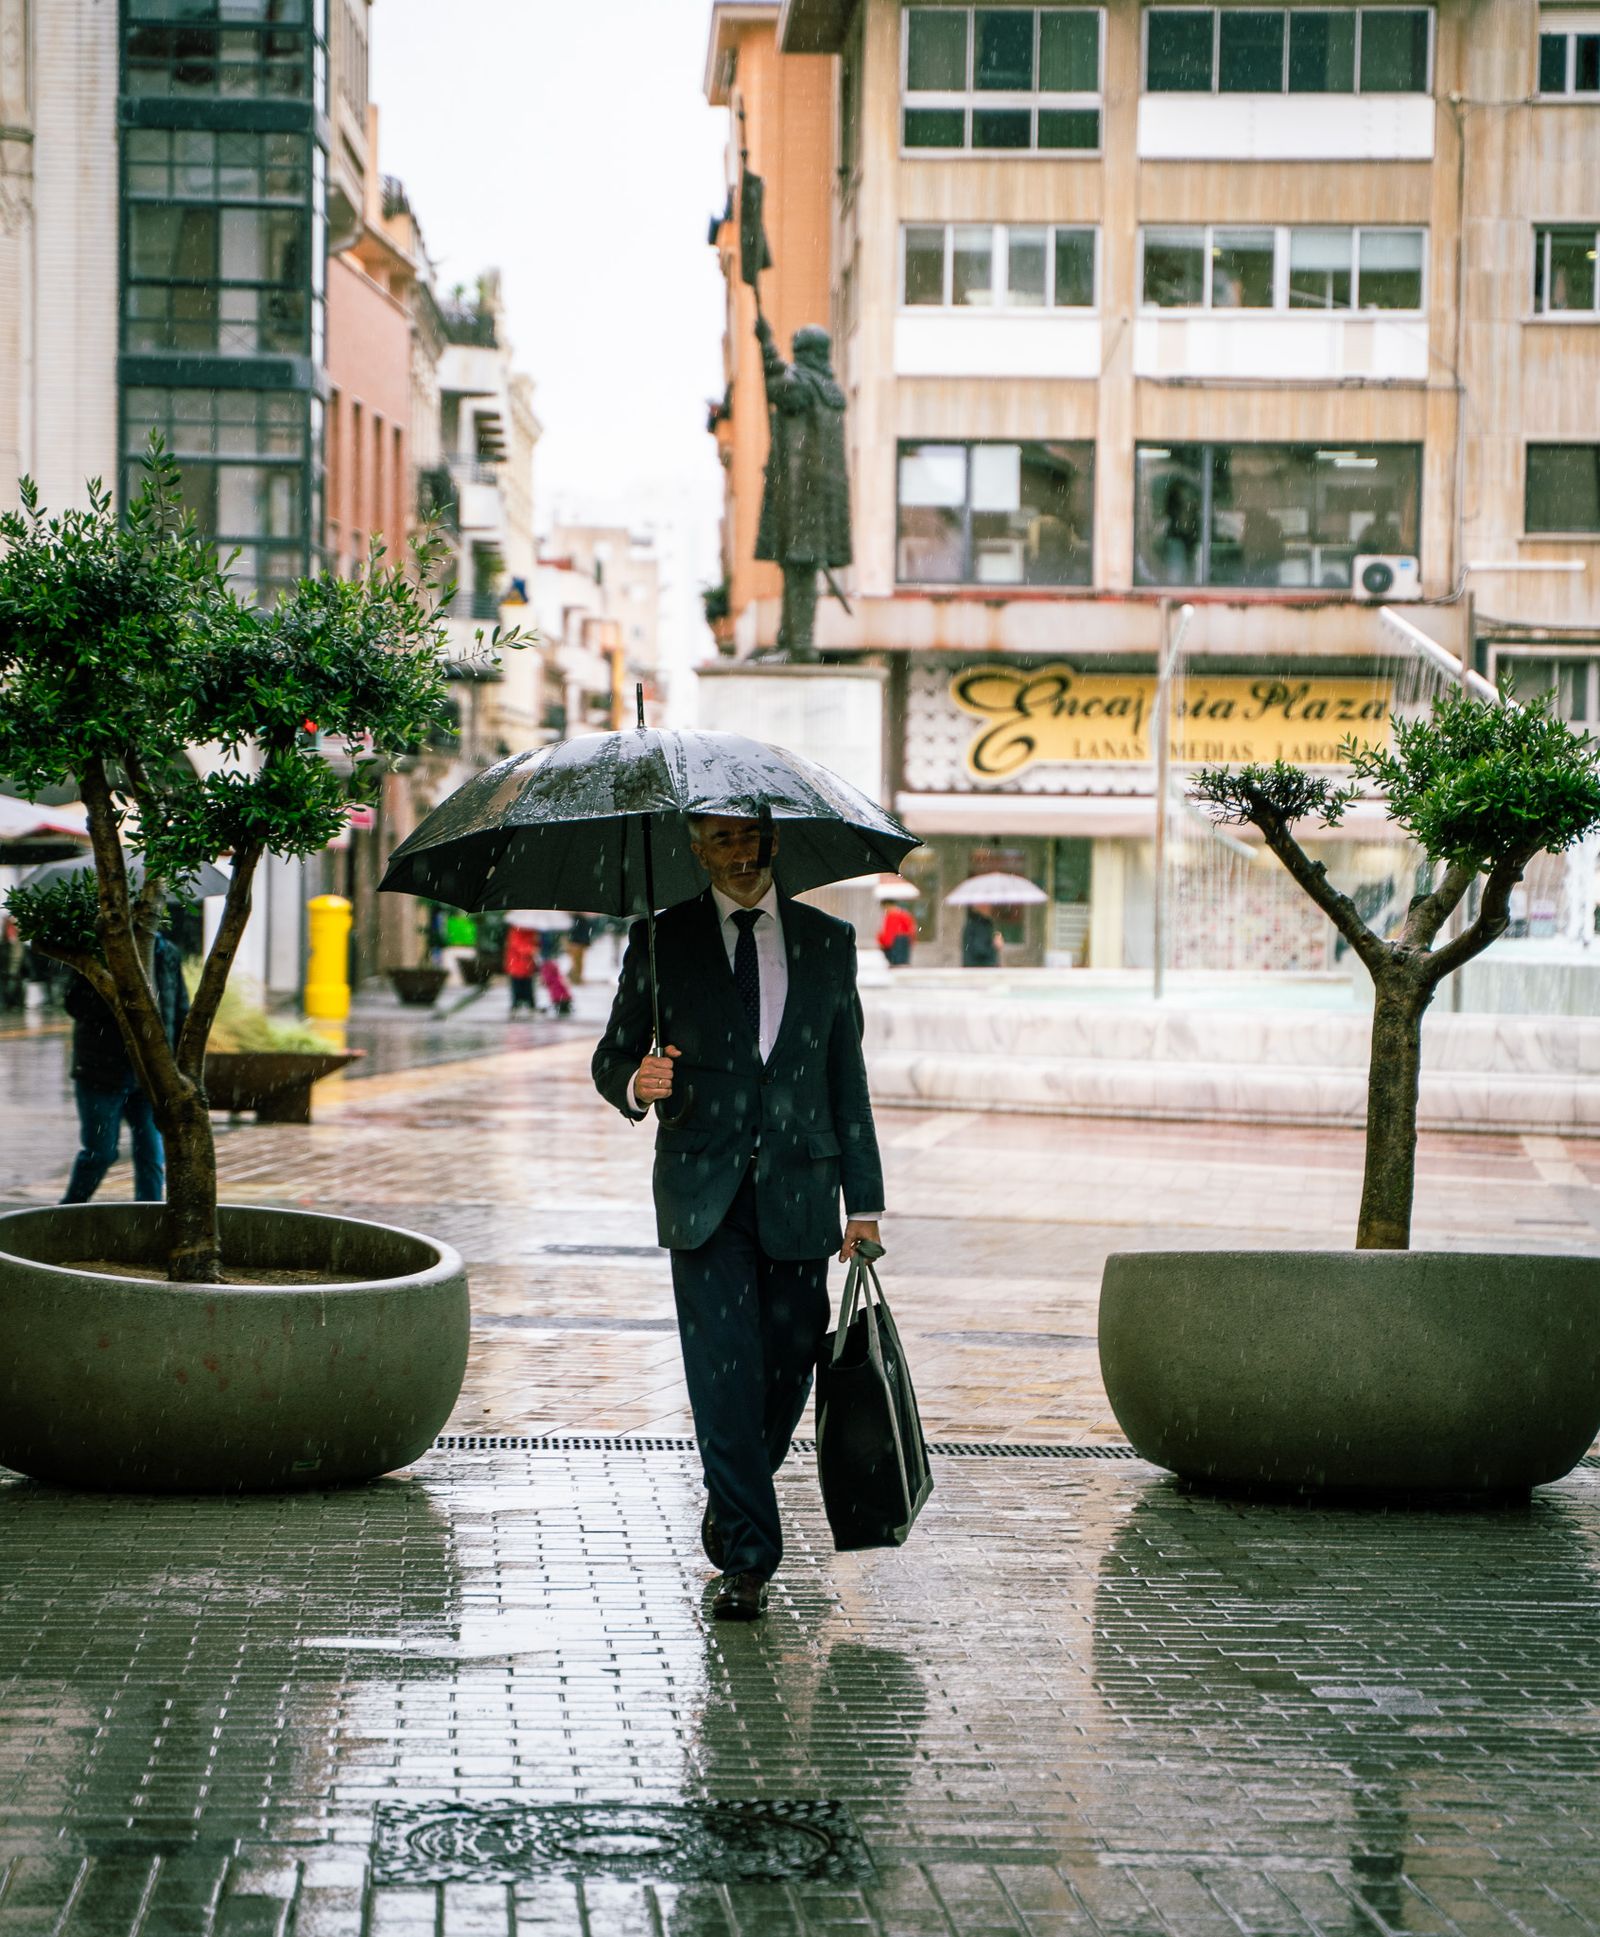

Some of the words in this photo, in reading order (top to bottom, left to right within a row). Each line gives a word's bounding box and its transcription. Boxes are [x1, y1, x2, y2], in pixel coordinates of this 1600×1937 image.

[1244, 679, 1388, 720] Plaza
[1072, 736, 1145, 759] LANAS
[1169, 739, 1254, 762] MEDIAS
